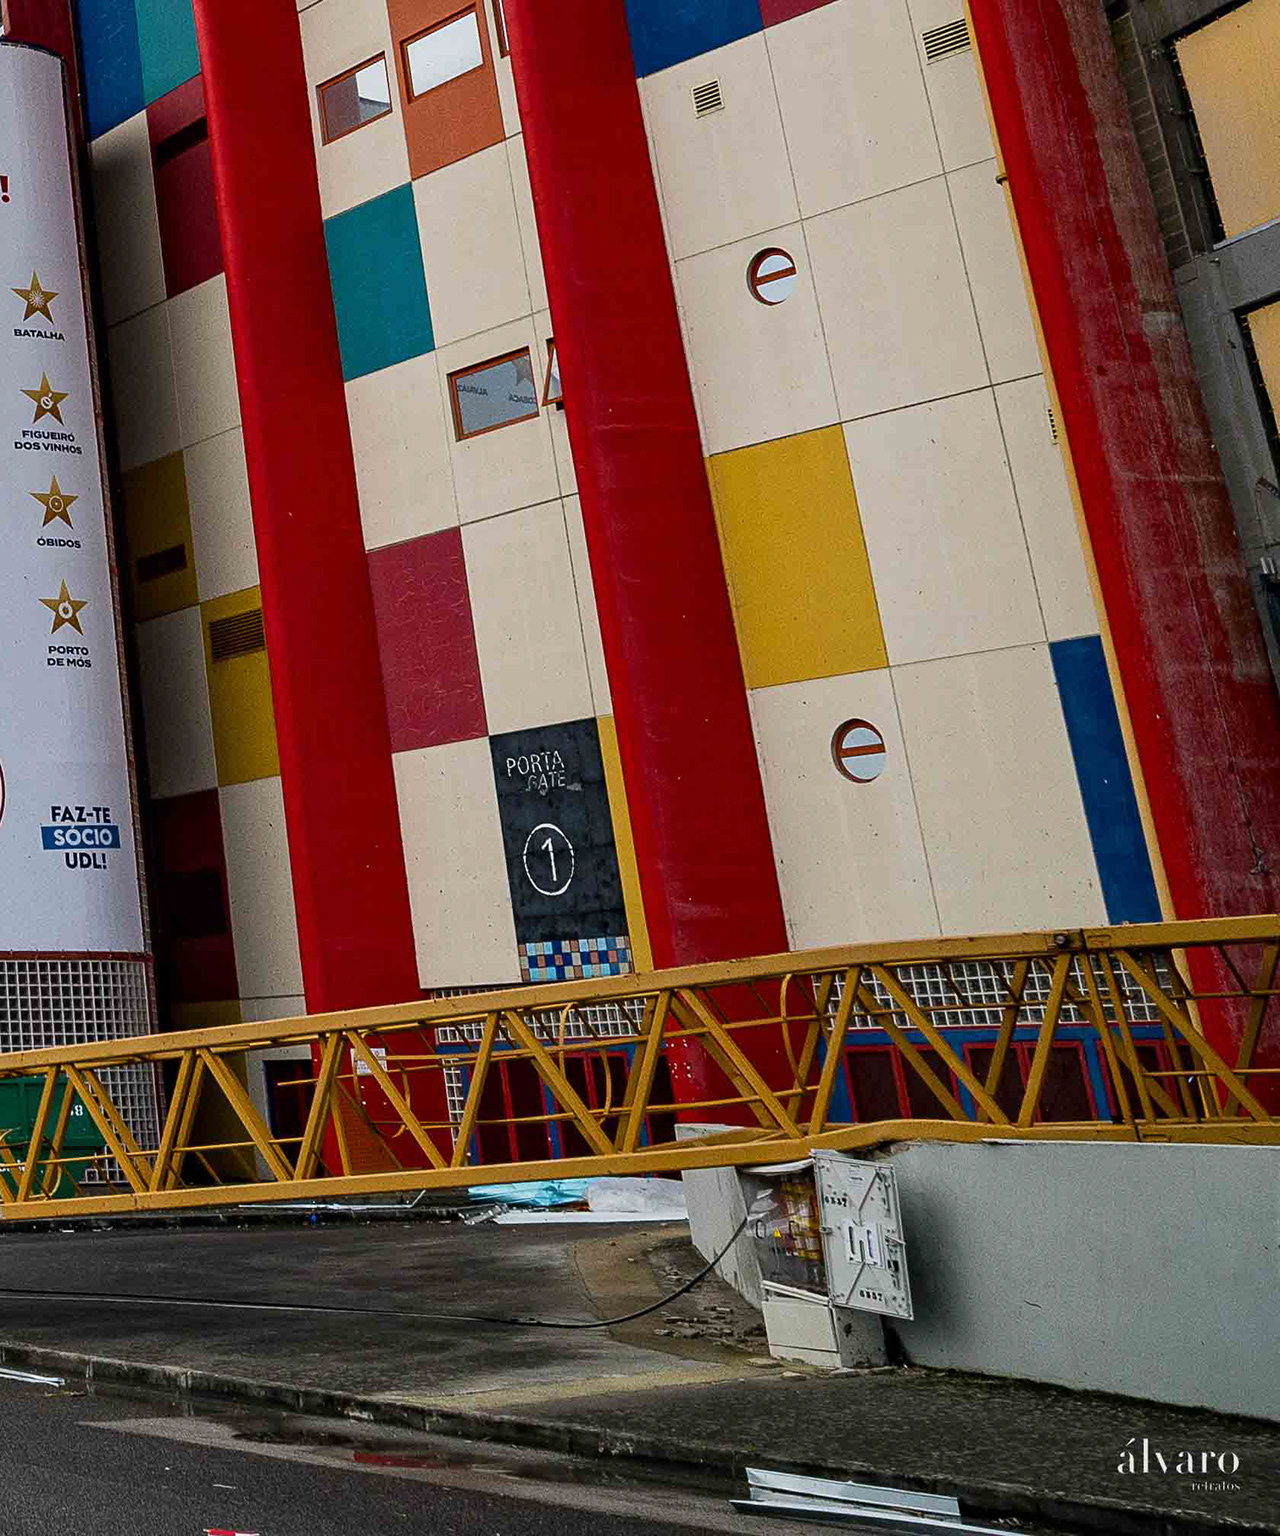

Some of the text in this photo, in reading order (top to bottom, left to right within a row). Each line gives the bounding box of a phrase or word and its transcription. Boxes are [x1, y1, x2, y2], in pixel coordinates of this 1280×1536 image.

[13, 328, 65, 341] BATALHA
[22, 430, 75, 442] FIGUEIRÓ
[14, 442, 82, 455] DOS VINHOS
[37, 537, 81, 549] ÓBIDOS
[48, 645, 89, 656] PORTO
[47, 657, 92, 668] DE MÓS
[506, 750, 565, 778] PORTA
[527, 770, 566, 789] GATE
[51, 806, 111, 824] FAZ-TE
[53, 825, 112, 847] SÓCIO
[65, 853, 107, 869] UDL!
[541, 837, 557, 882] 1
